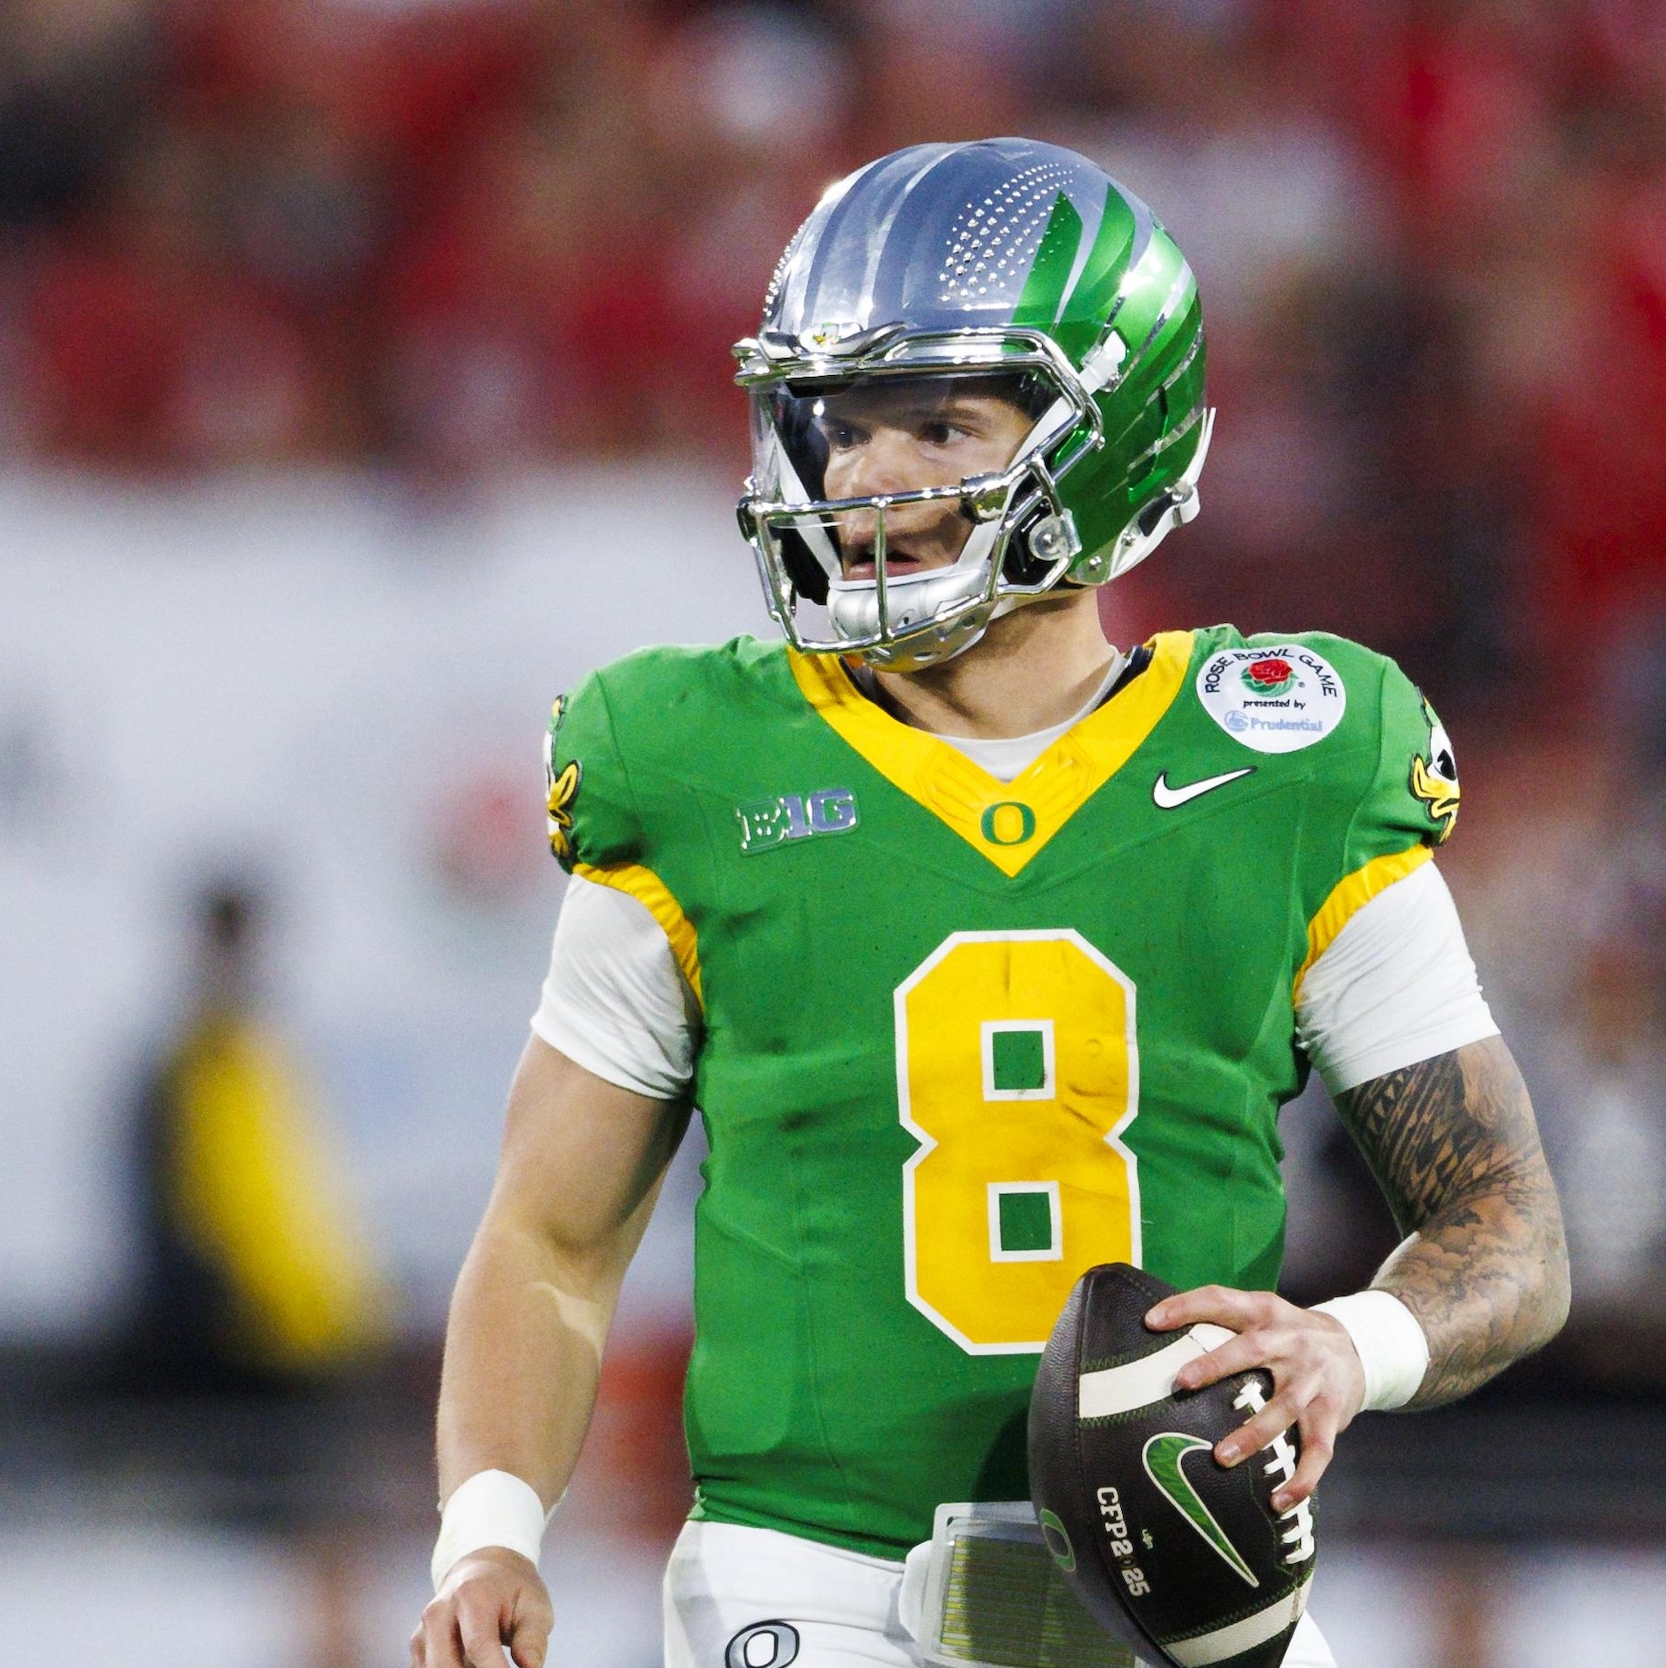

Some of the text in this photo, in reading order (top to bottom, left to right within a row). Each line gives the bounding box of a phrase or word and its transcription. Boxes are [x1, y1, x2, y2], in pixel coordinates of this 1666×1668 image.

[1204, 648, 1338, 698] ROSE BOWL GAME
[1243, 699, 1306, 710] presented by
[1250, 717, 1323, 732] Prudential
[893, 927, 1143, 1356] 8
